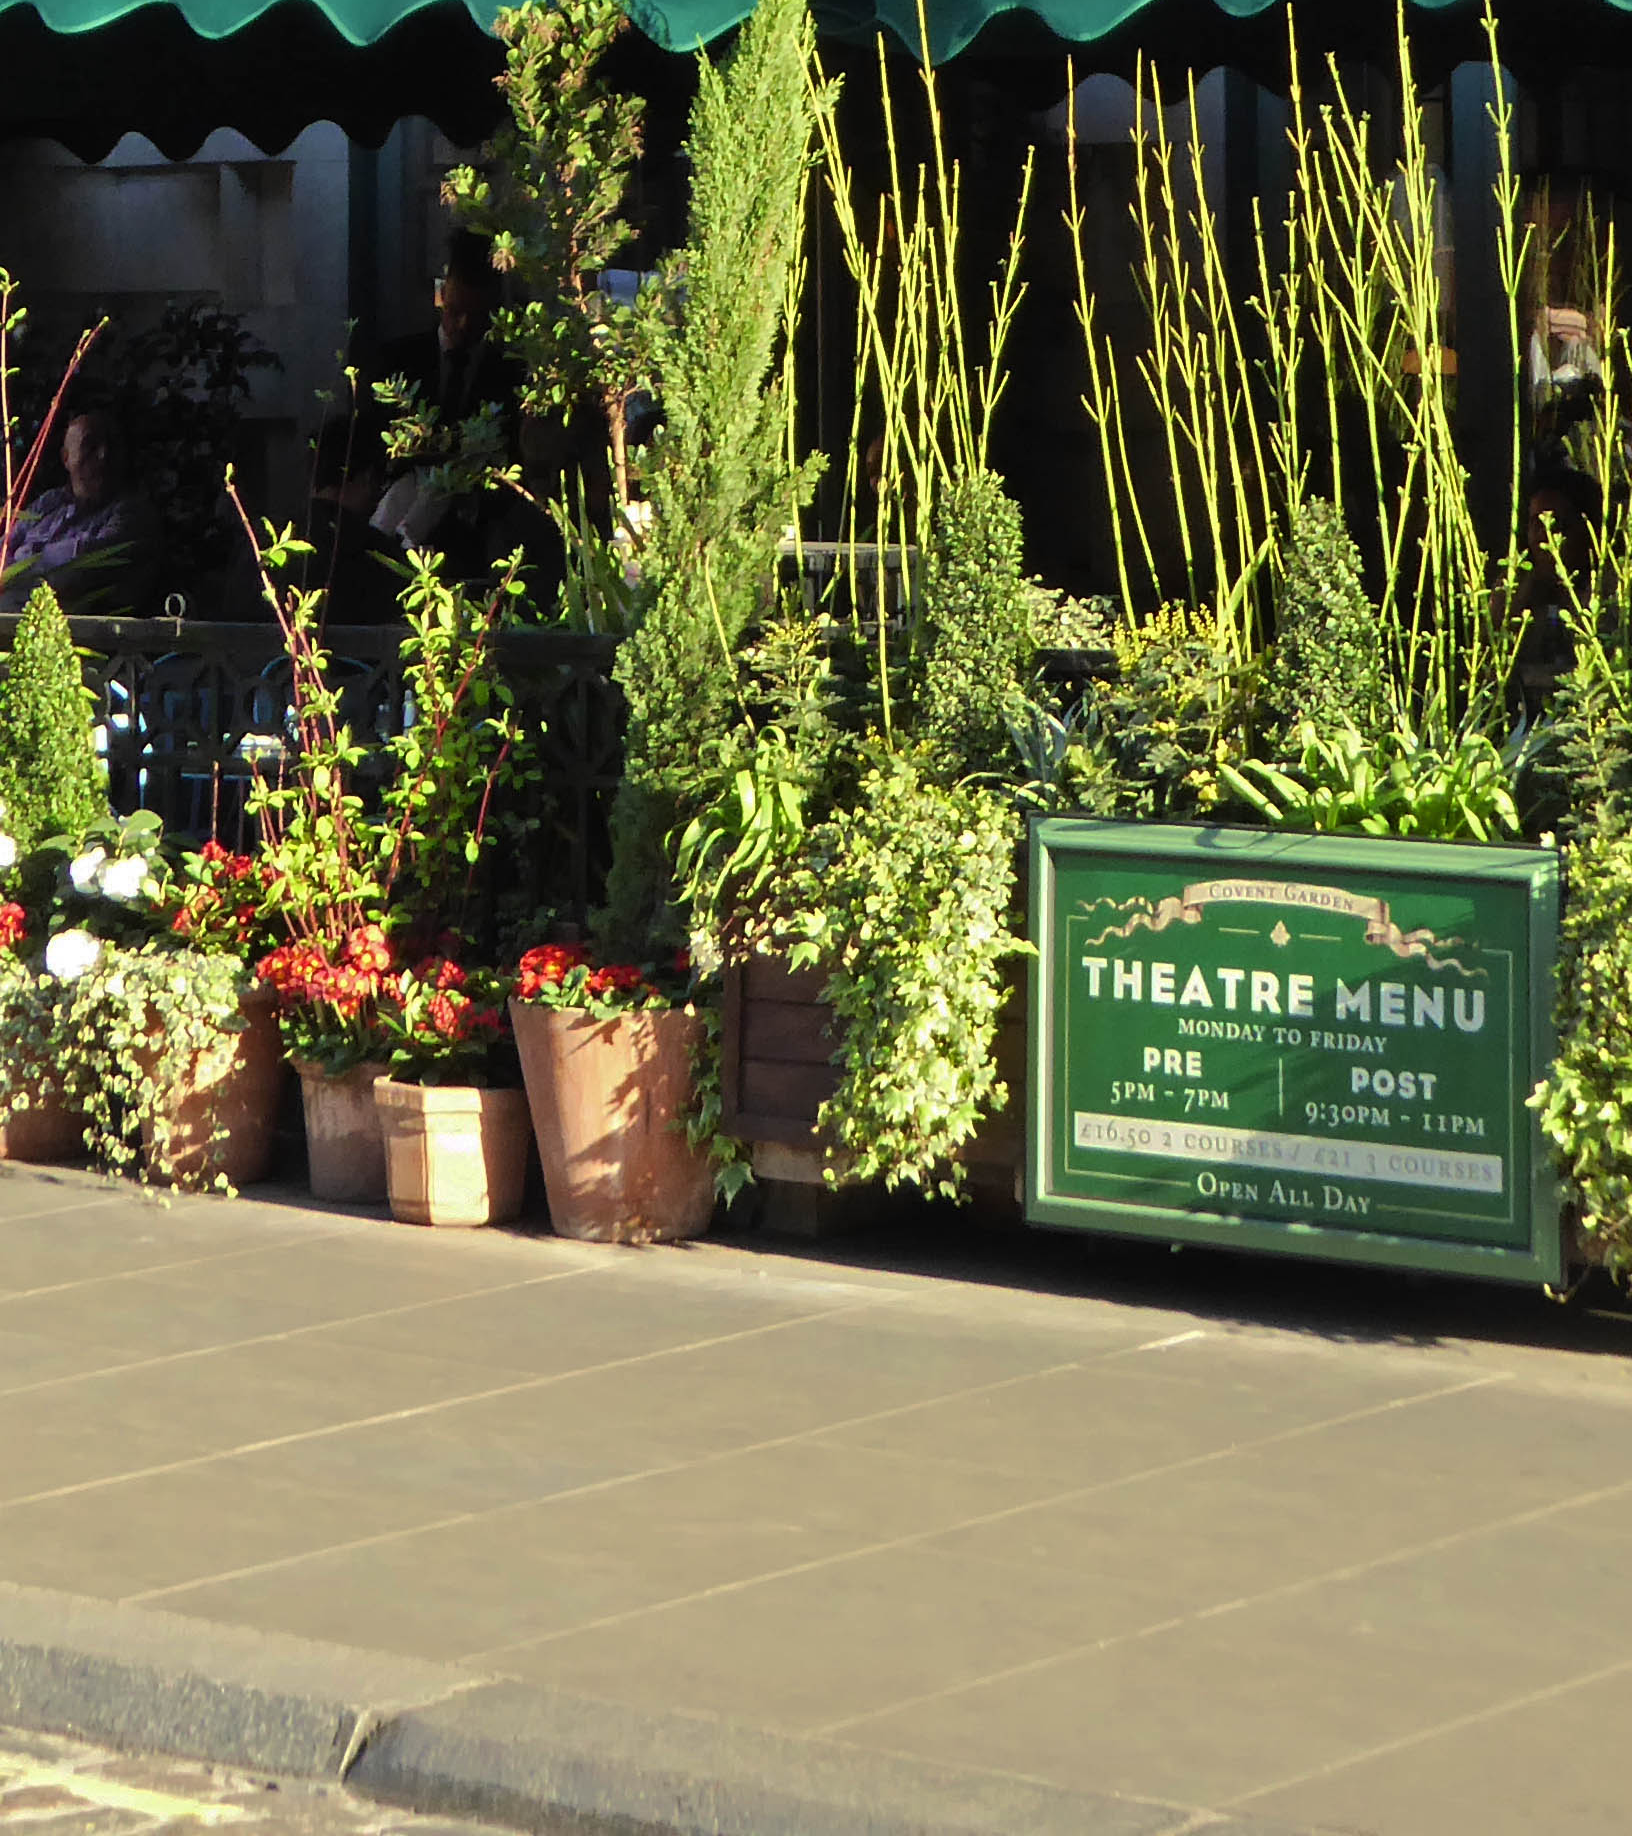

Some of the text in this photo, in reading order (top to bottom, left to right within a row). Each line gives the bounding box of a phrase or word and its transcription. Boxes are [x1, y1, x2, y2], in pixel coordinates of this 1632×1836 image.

[1081, 956, 1485, 1032] THEATRE MENU
[1178, 1017, 1388, 1054] MONDAY TO FRIDAY
[1143, 1046, 1203, 1078] PRE
[1110, 1081, 1155, 1105] 5PM
[1183, 1087, 1231, 1113] 7PM
[1351, 1066, 1437, 1101] POST
[1305, 1101, 1391, 1128] 9:30PM
[1422, 1113, 1485, 1137] 11PM
[1079, 1120, 1152, 1149] £16.50
[1184, 1132, 1283, 1160] COURSES
[1388, 1155, 1494, 1183] COURSES
